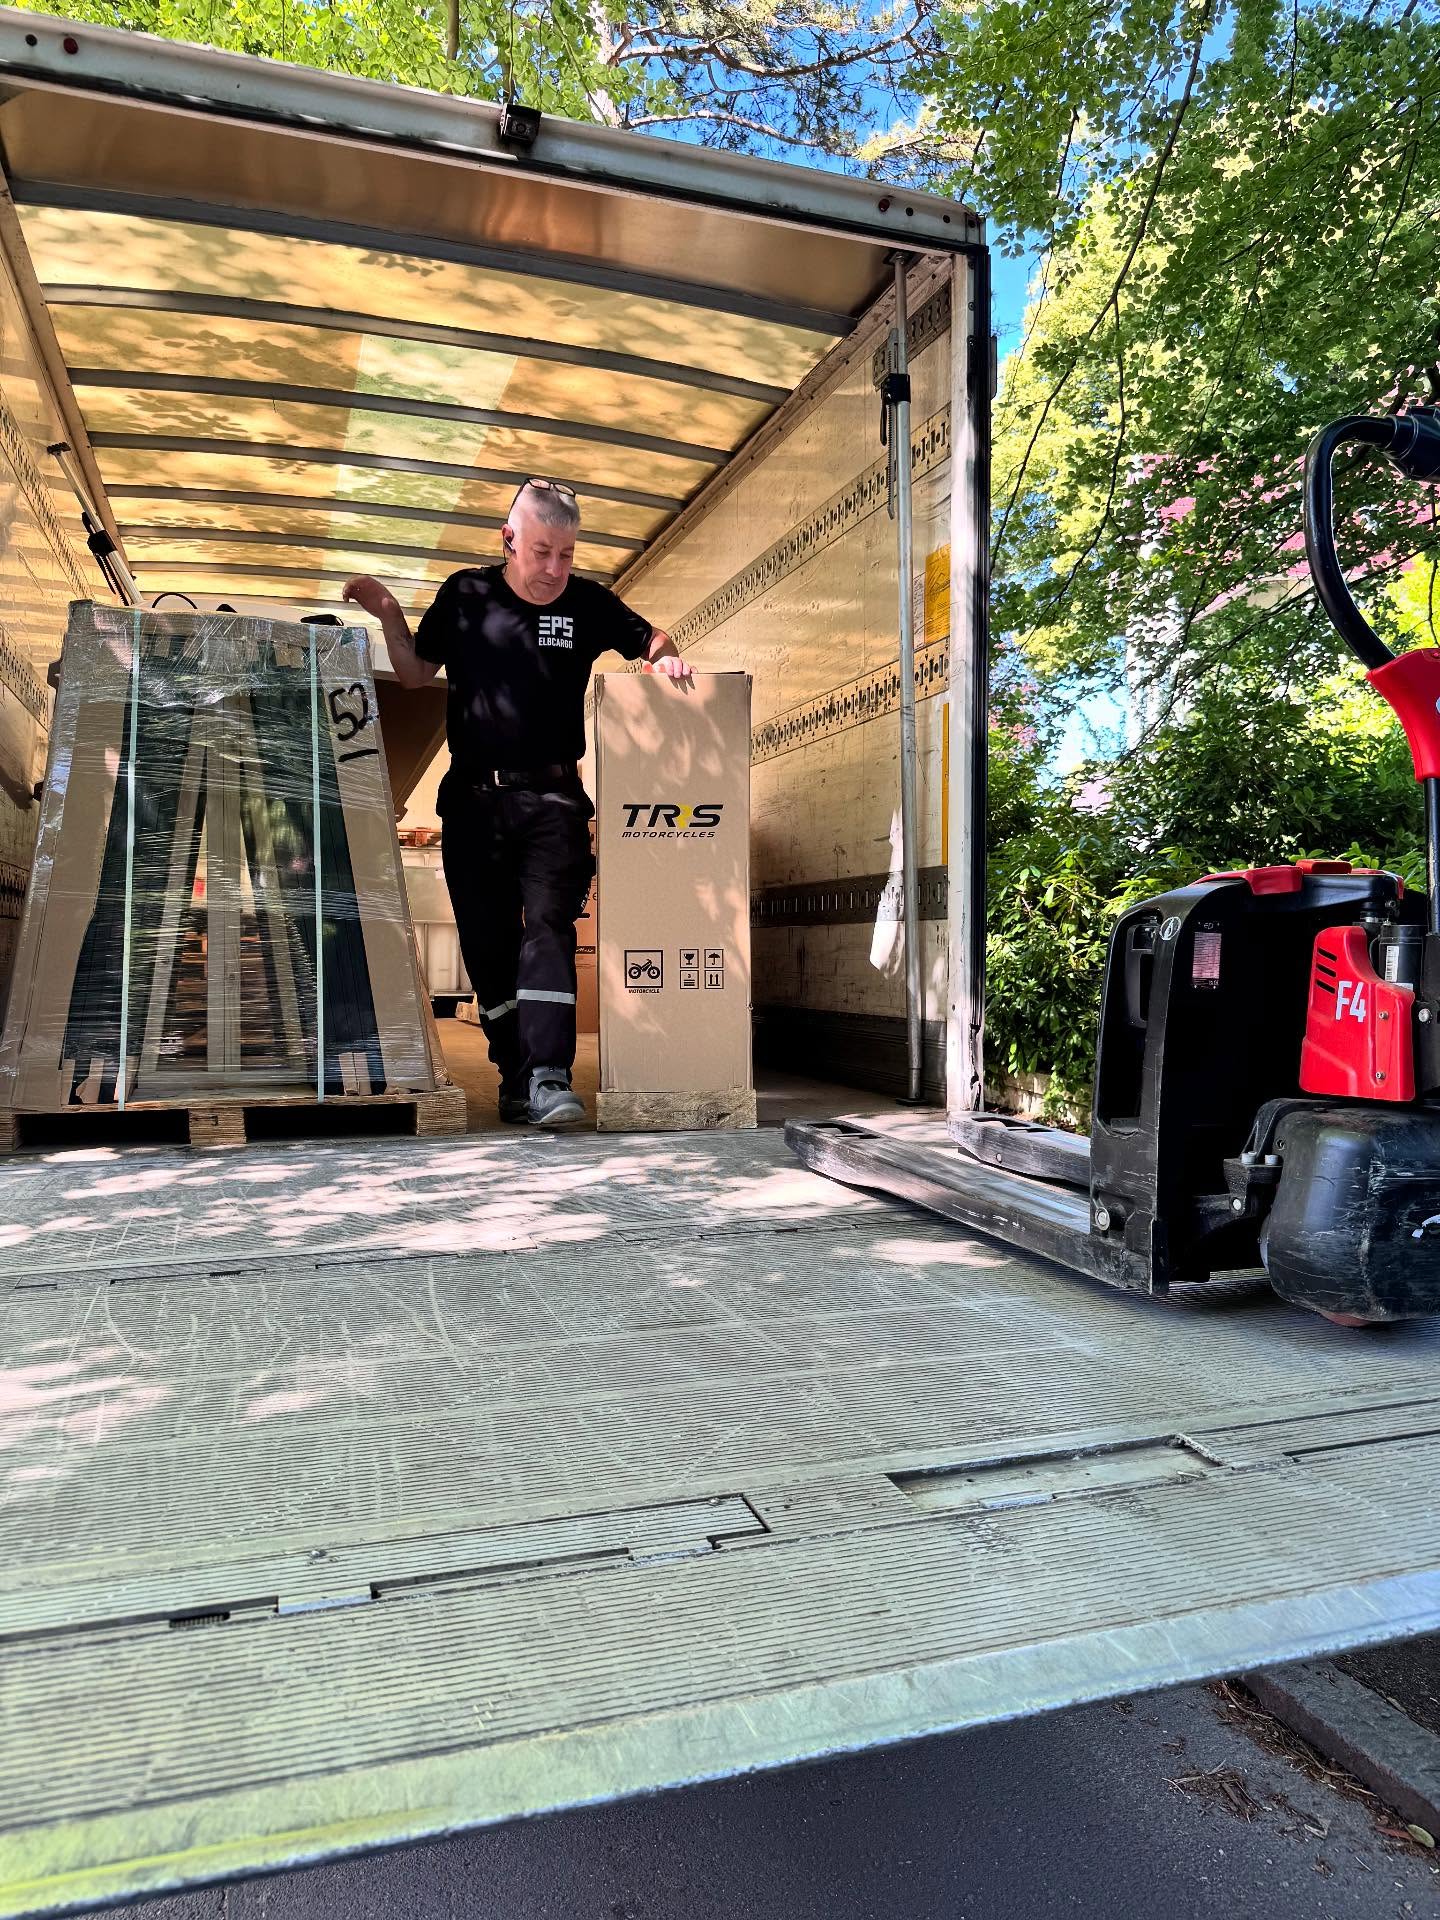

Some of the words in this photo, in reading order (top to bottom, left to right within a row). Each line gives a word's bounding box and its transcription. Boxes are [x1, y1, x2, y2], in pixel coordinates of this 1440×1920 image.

[538, 615, 574, 638] EPS
[538, 637, 573, 649] ELBCARGO
[328, 682, 379, 741] 52
[621, 831, 716, 839] MOTORCYCLES
[1335, 980, 1367, 1023] F4
